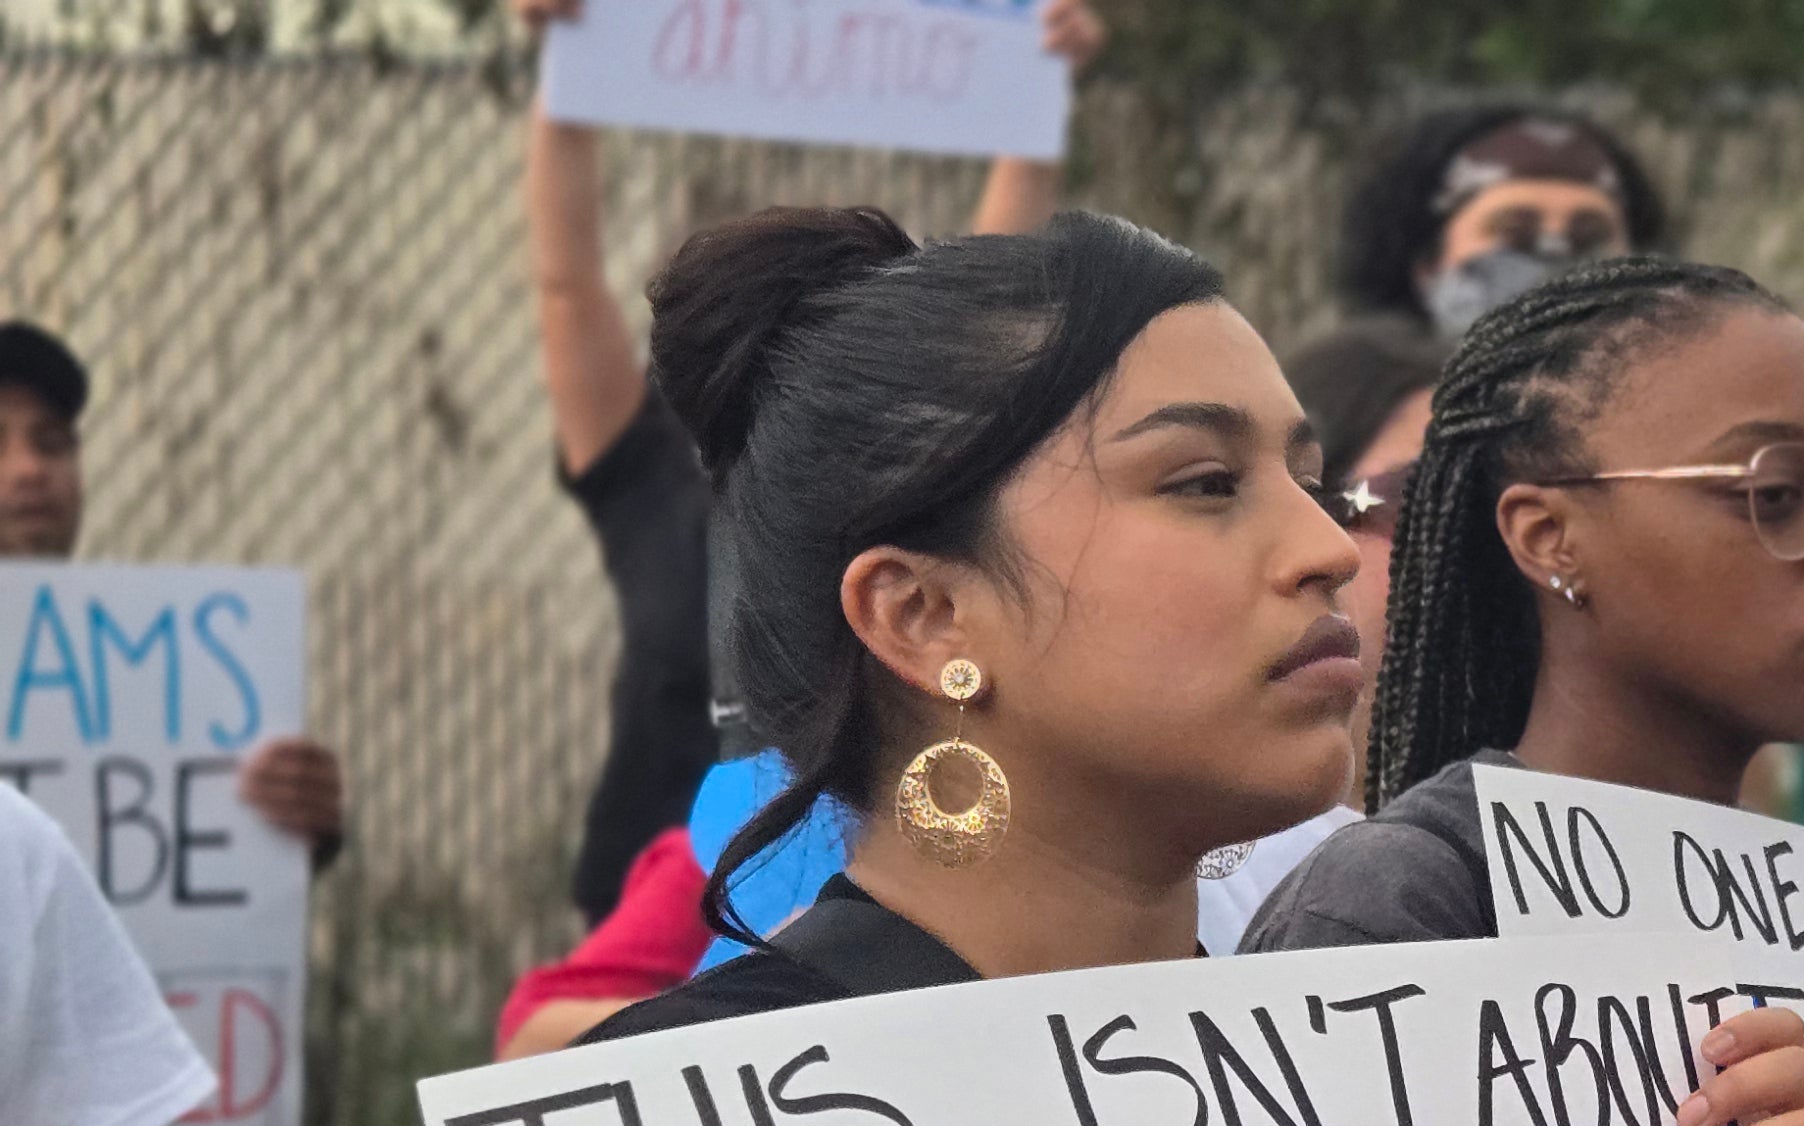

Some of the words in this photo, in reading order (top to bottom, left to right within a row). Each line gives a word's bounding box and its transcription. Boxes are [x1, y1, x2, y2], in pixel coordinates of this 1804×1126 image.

[6, 584, 261, 749] AMS
[96, 756, 248, 907] BE
[1492, 800, 1630, 918] NO
